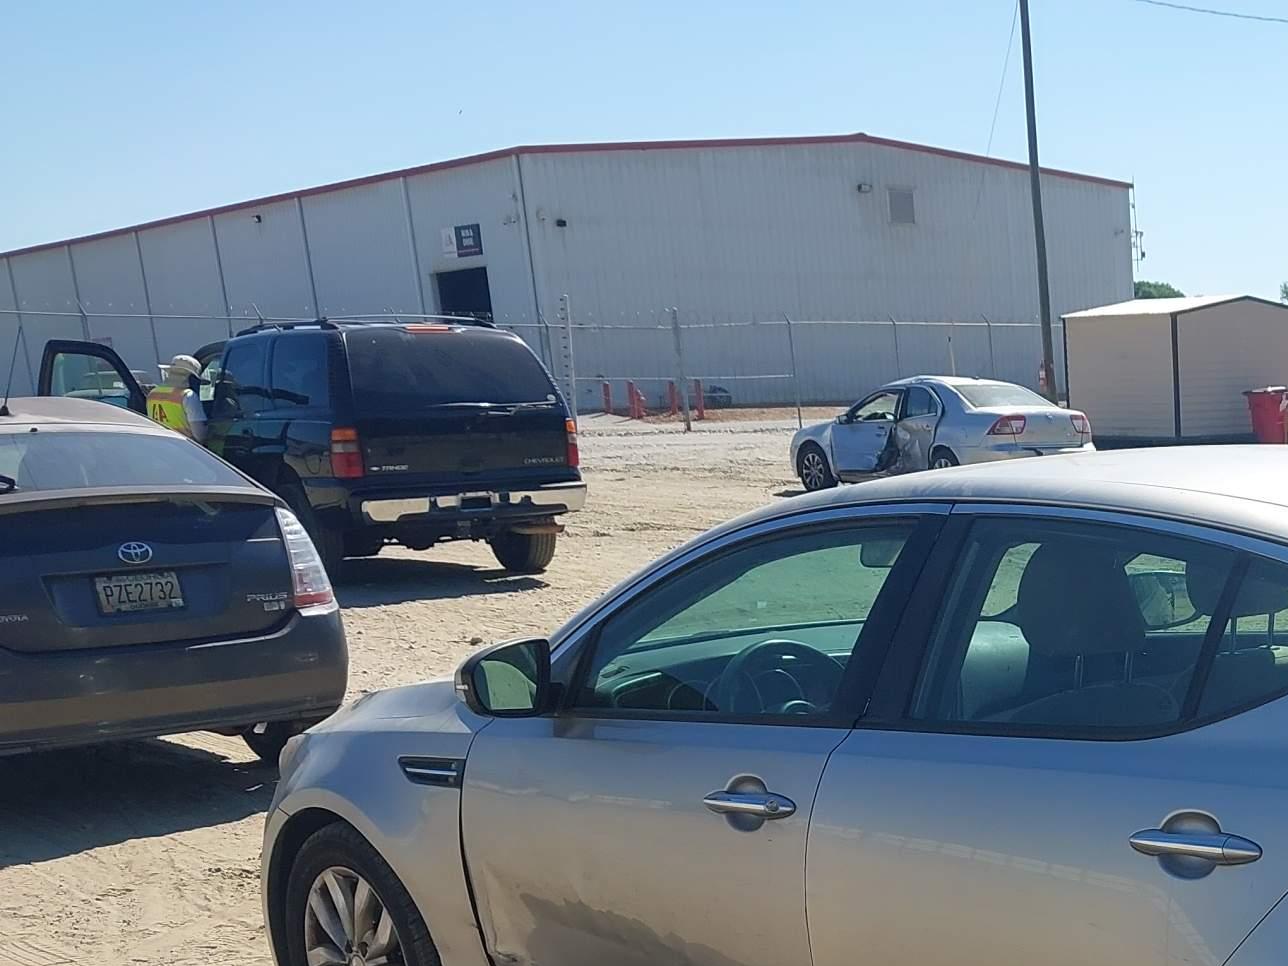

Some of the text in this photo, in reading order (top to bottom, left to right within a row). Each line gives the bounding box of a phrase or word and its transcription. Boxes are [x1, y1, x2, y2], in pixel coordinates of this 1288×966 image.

[103, 580, 178, 604] PZE2732
[246, 591, 288, 602] PRIUS
[0, 614, 29, 623] OYOTA
